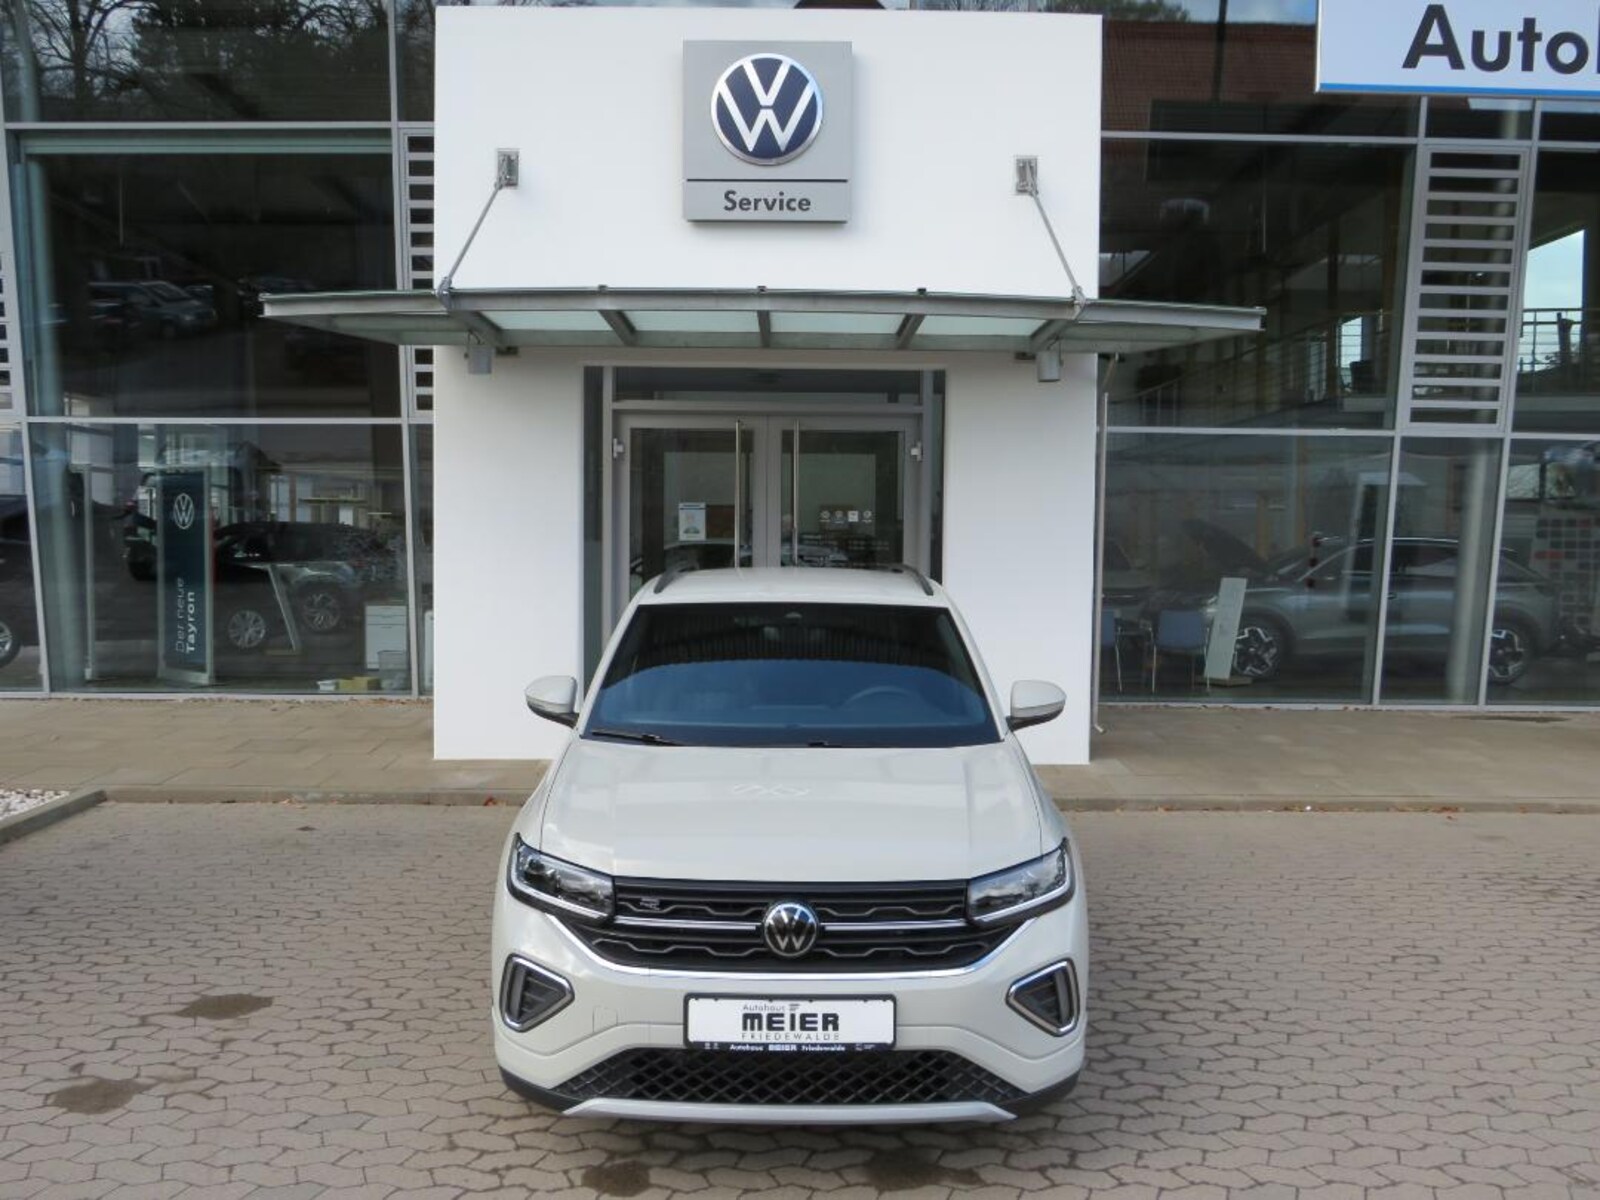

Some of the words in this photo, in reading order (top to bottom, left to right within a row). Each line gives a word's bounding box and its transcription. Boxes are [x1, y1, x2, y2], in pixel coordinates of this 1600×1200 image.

[1402, 3, 1600, 75] Auto
[723, 189, 811, 212] Service
[176, 577, 185, 619] neue
[186, 591, 198, 654] Tayron
[175, 623, 185, 653] Der
[742, 1003, 785, 1012] Autohaus
[742, 1012, 840, 1032] MEIER
[729, 1043, 764, 1051] Autohaus
[741, 1032, 840, 1041] FRIEDEWALDE
